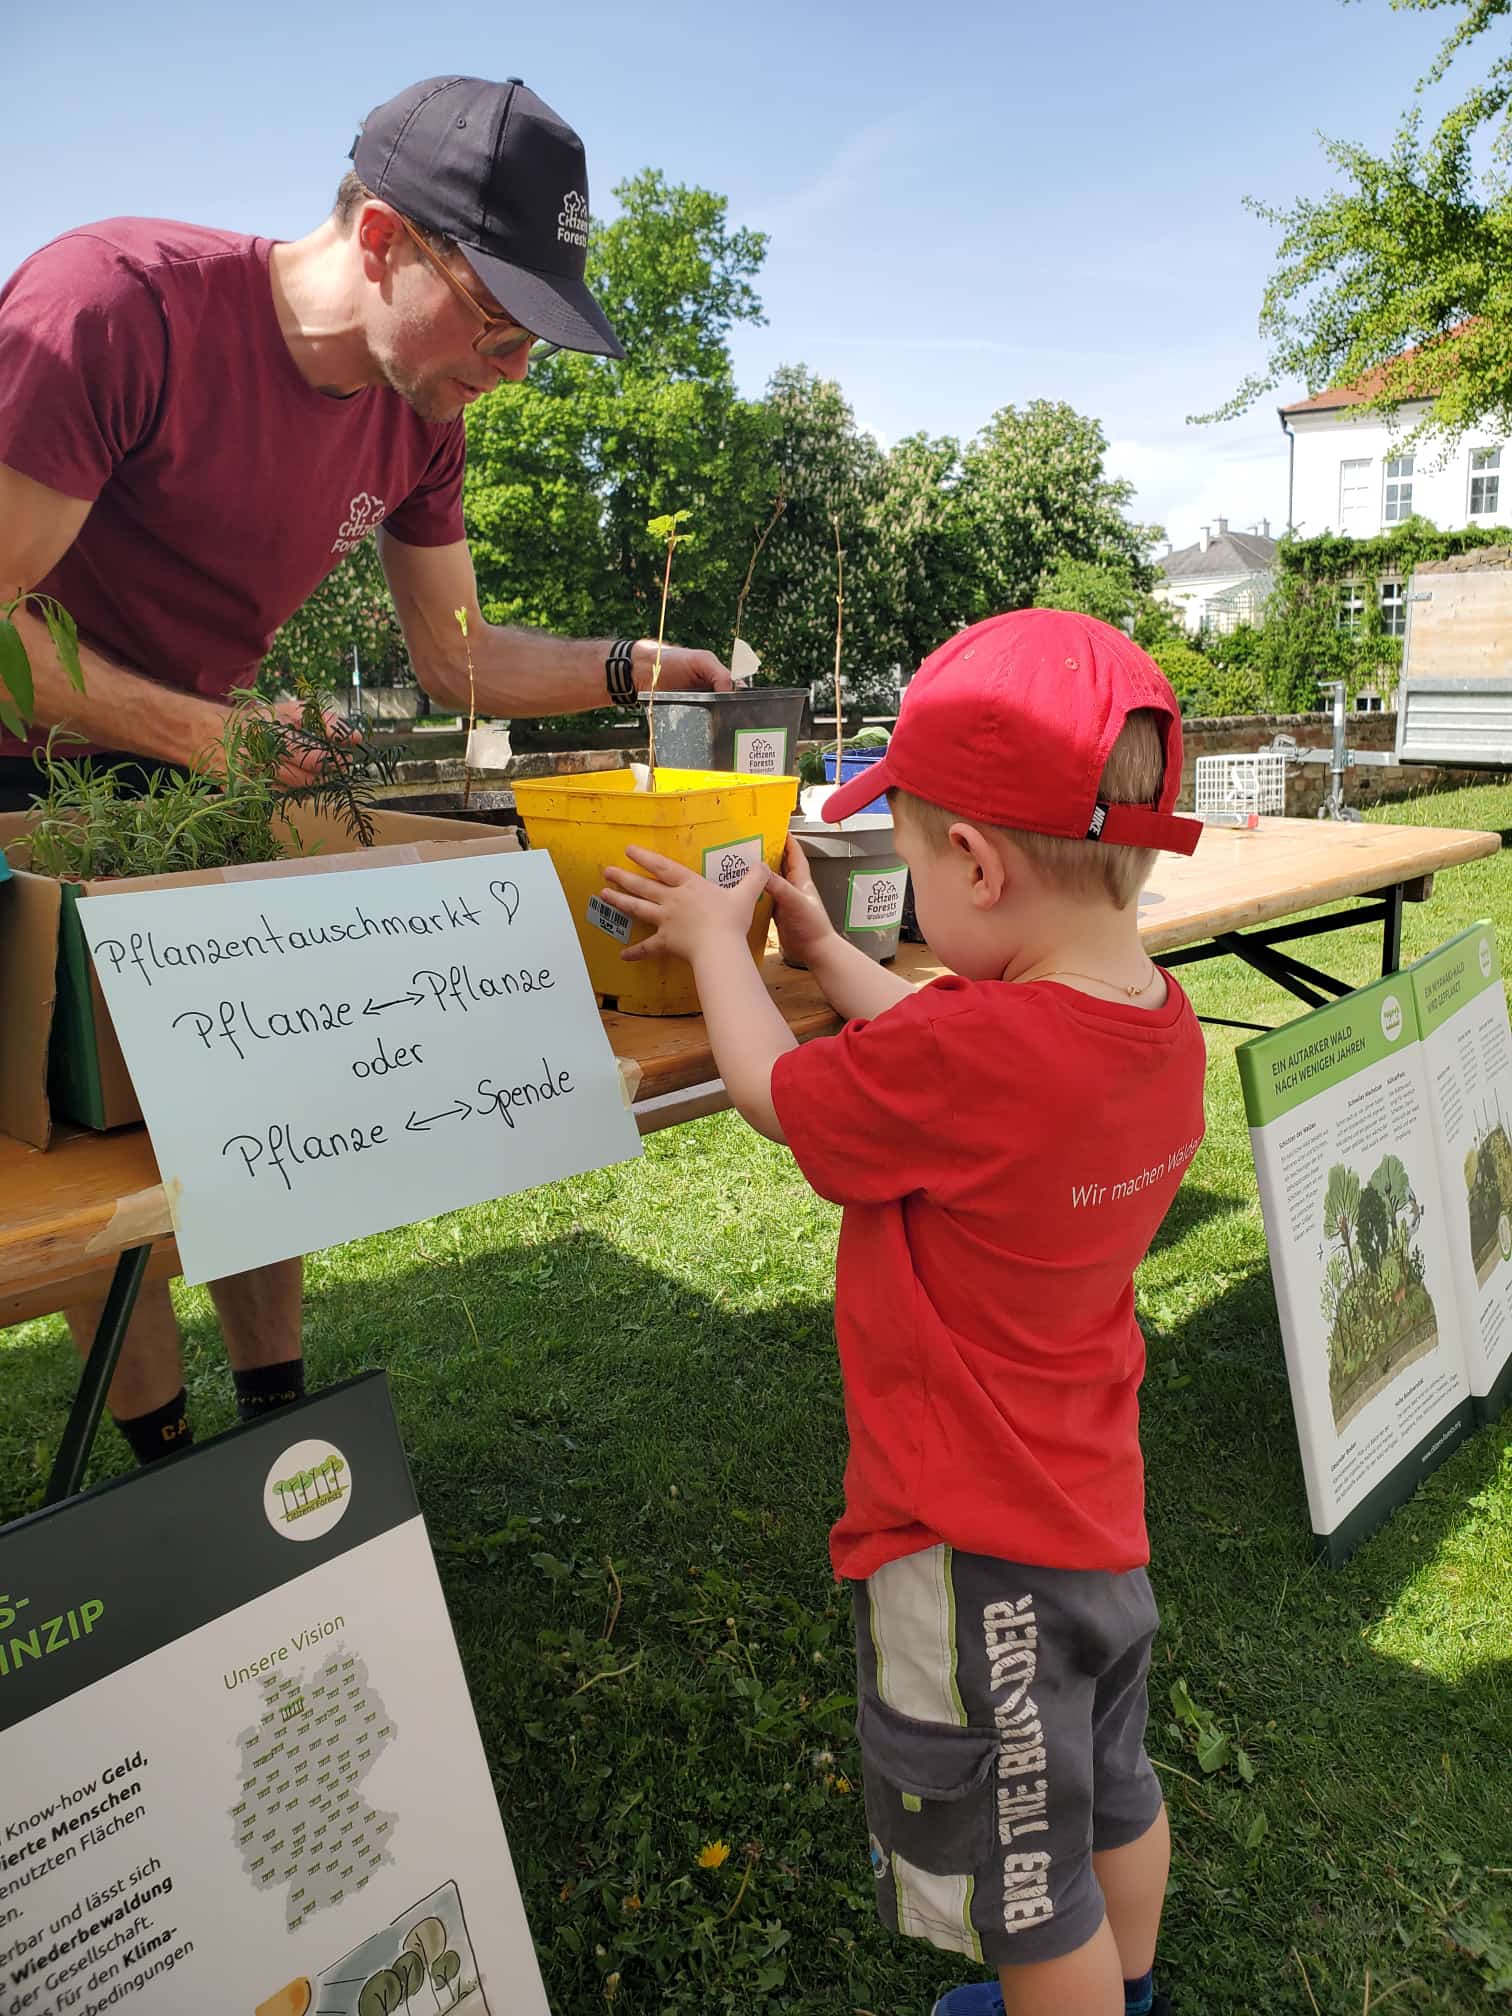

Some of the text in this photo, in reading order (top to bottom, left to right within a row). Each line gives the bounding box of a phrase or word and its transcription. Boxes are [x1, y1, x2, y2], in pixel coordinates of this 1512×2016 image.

[749, 759, 774, 769] Forests
[1088, 806, 1106, 836] NIKE
[94, 896, 482, 986] Pflanzentauschmarkt
[867, 892, 899, 904] Citizens
[867, 902, 897, 913] Forests
[172, 964, 556, 1060] Pflanze Pflanze
[1272, 1026, 1352, 1076] EIN AUTARKER WALD
[351, 1037, 425, 1079] oder
[1274, 1038, 1366, 1096] NACH WENIGEN JAHREN
[222, 1057, 576, 1190] Pflanze Spende
[1072, 1183, 1107, 1209] Wir
[1111, 1163, 1165, 1201] machen
[223, 1616, 345, 1690] Unsere Vision
[0, 1782, 141, 1872] ierte Menschen
[5, 1751, 148, 1841] Know-how Geld,
[0, 1804, 146, 1900] enutzten Flächen
[0, 1856, 161, 1967] erbar und lässt sich
[10, 1876, 173, 1985] Wiederbewaldung
[9, 1916, 155, 2016] der Gesellschaft.
[56, 1927, 178, 2013] für den Klima-
